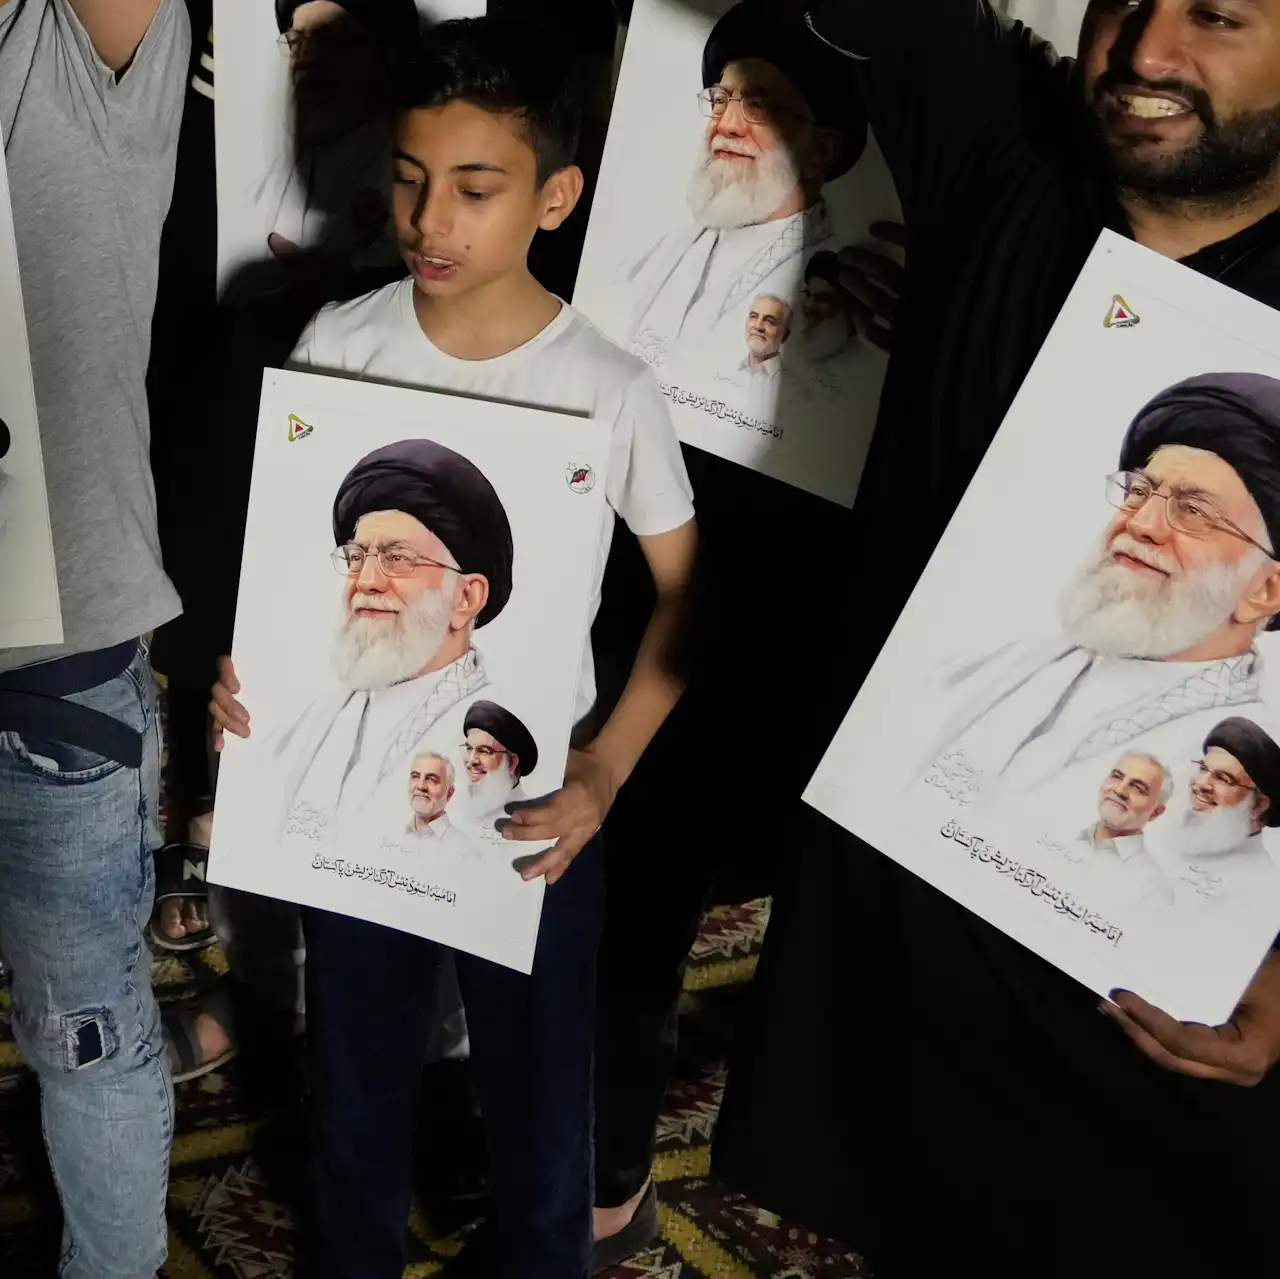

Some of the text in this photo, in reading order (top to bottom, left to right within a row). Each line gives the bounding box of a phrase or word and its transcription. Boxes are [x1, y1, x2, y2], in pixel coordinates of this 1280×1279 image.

[940, 818, 984, 859] پاکستان
[312, 852, 345, 878] پاکستان
[429, 885, 457, 907] امامیہ
